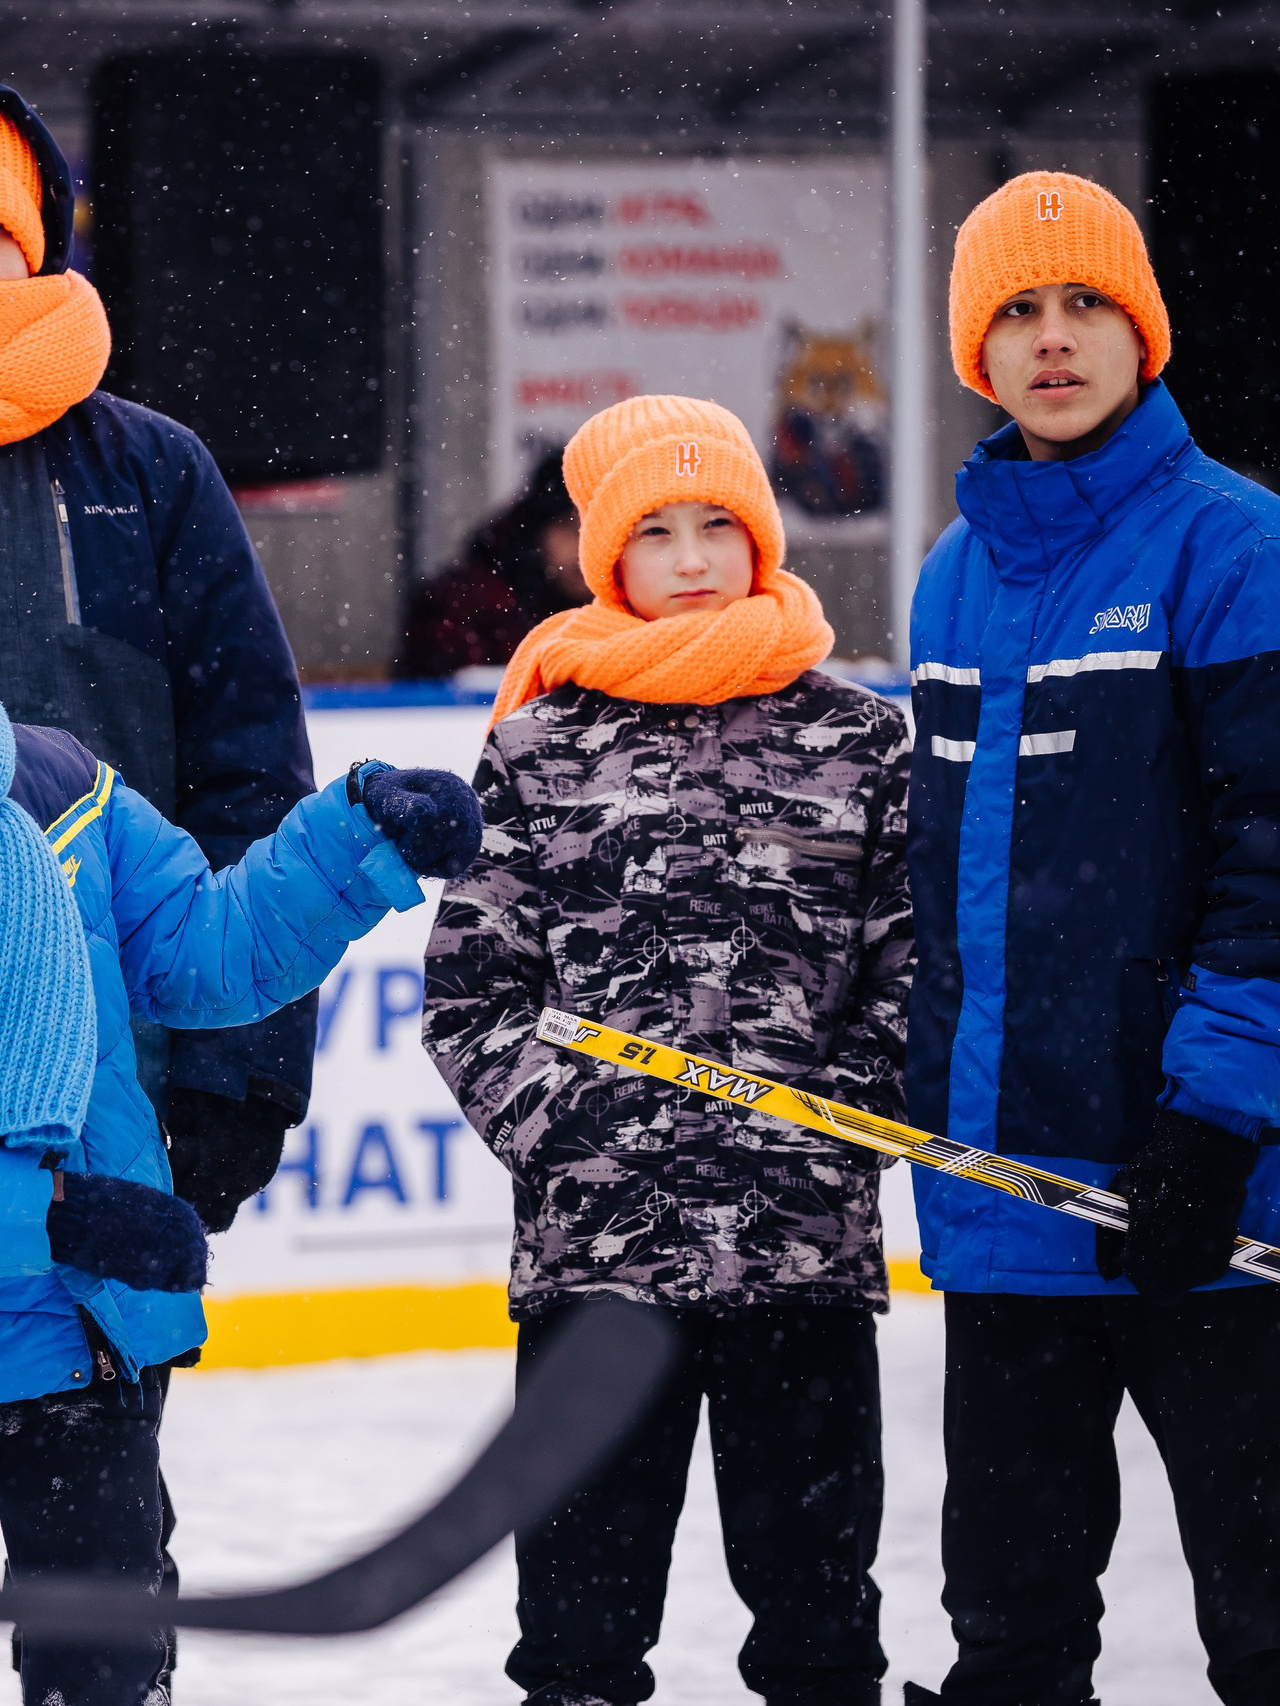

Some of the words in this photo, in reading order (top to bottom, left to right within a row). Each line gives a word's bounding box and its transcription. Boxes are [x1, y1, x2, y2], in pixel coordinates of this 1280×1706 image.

[739, 801, 774, 815] BATTLE
[674, 1057, 775, 1104] MAX
[696, 1164, 727, 1179] REIKE
